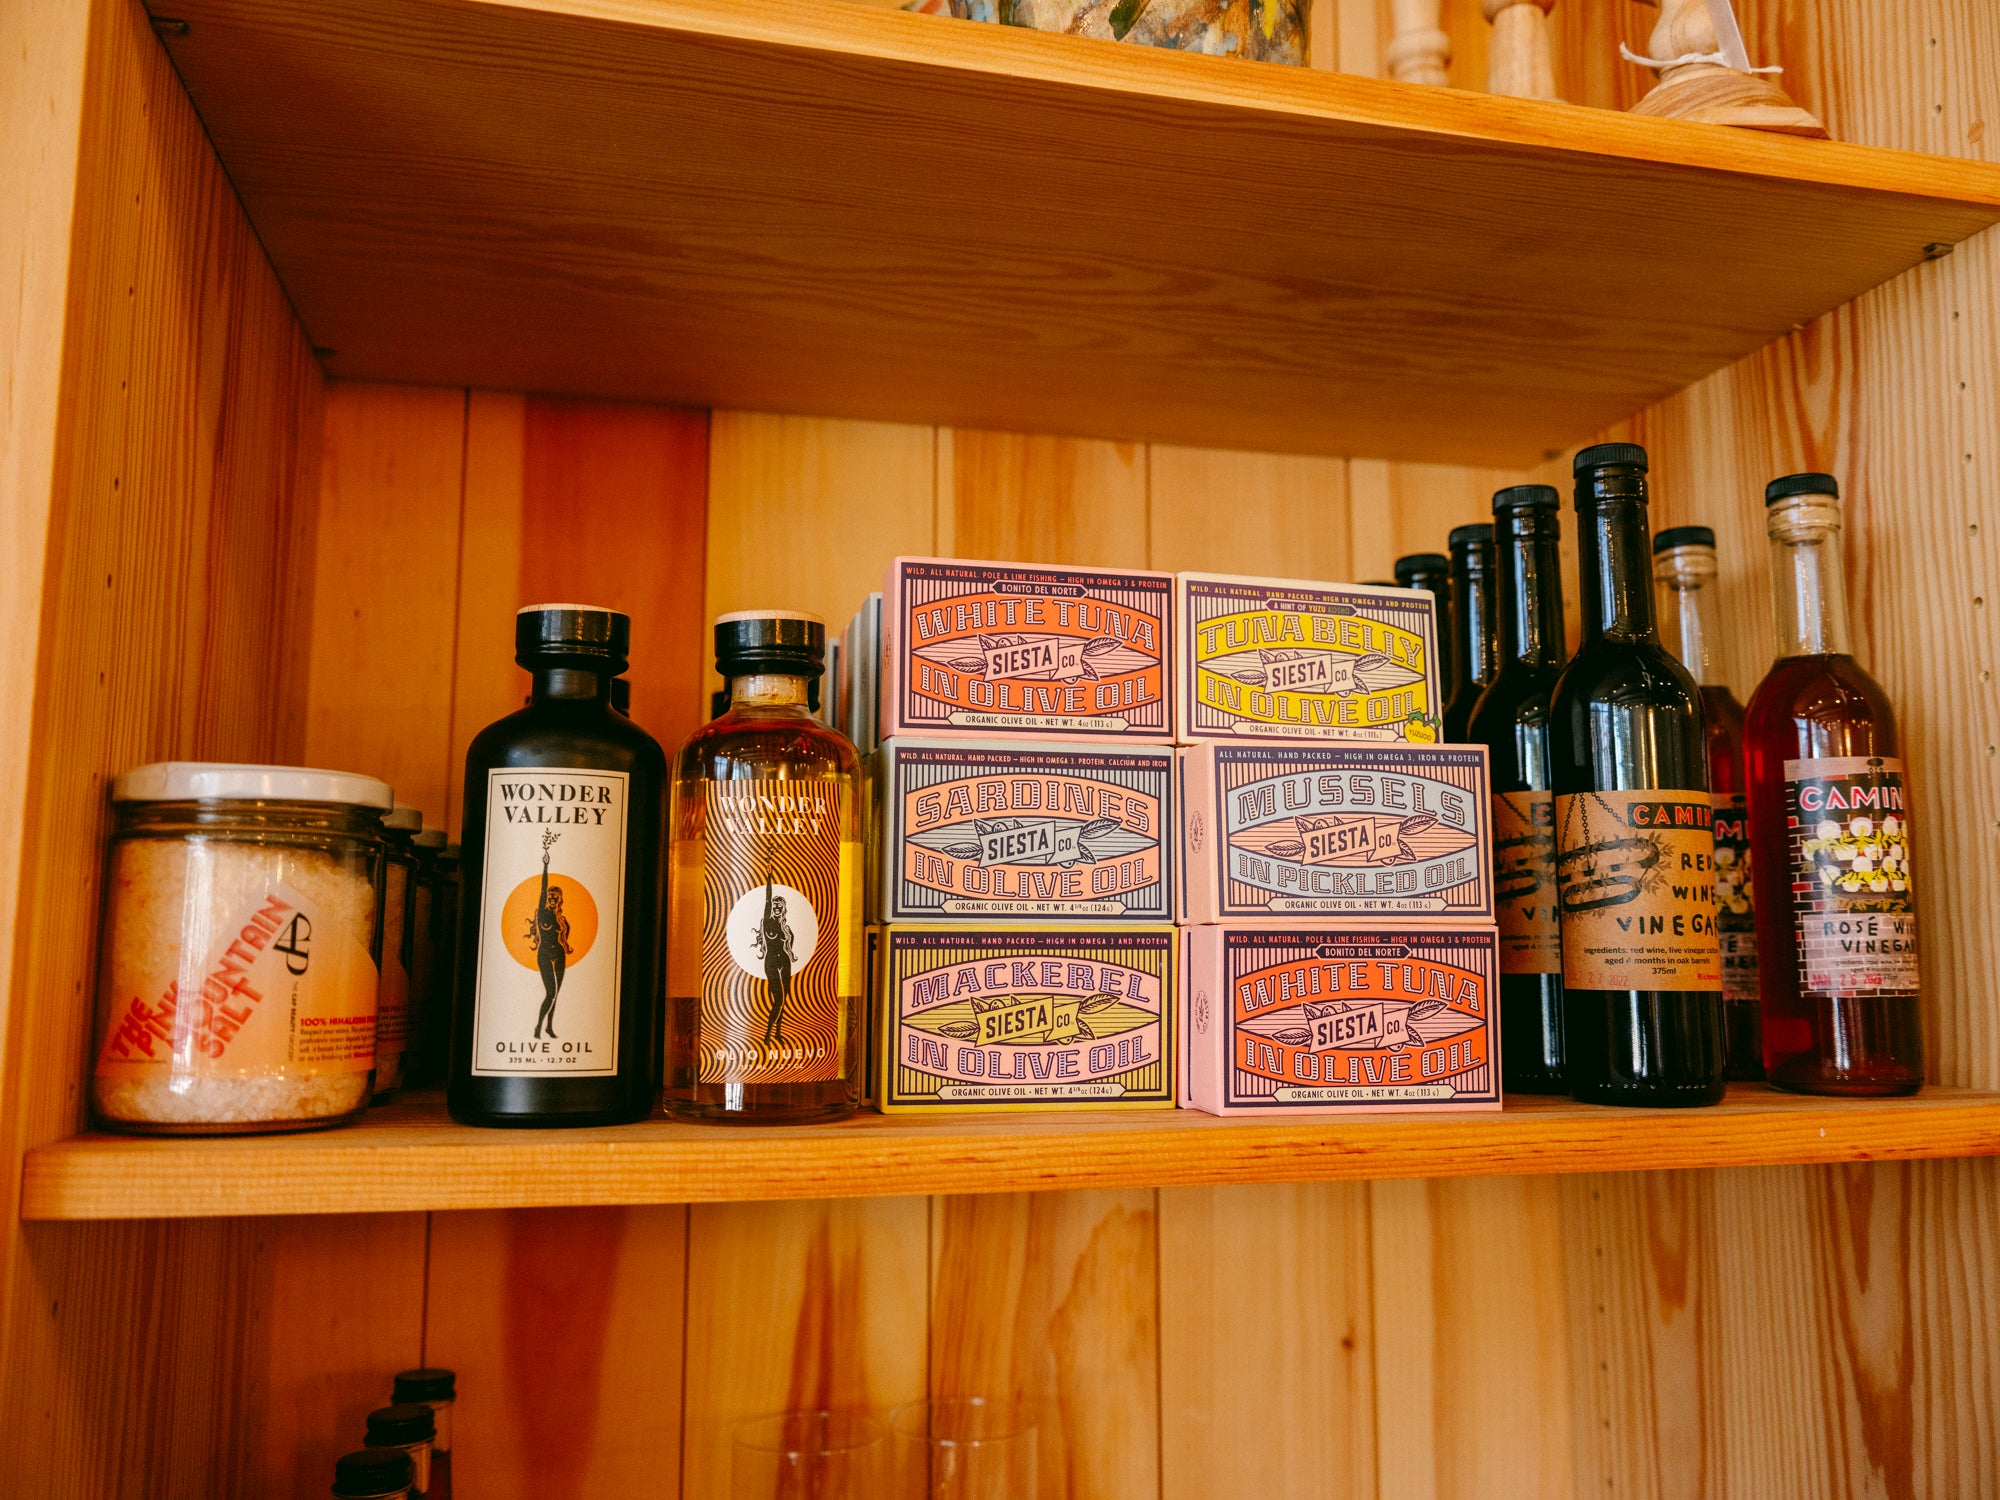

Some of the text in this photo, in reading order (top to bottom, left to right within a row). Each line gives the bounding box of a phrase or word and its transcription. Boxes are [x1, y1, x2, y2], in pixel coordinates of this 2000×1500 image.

[983, 571, 1000, 580] POLE
[1029, 574, 1057, 583] FISHING
[1067, 576, 1085, 584] HIGH
[1096, 578, 1121, 586] OMEGA
[1001, 583, 1078, 596] BONITO DEL NORTE
[1214, 586, 1227, 594] ALL
[1288, 592, 1314, 600] PACKED
[1322, 595, 1339, 603] HIGH
[1352, 598, 1376, 606] OMEGA
[1385, 600, 1399, 608] AND
[1401, 602, 1430, 610] PROTEIN
[1280, 602, 1350, 615] HINT YUZU KOSHO
[916, 598, 1155, 650] WHITE TUNA
[1199, 615, 1421, 668] TUNA BELLY
[993, 645, 1053, 675] SIESTA
[1272, 660, 1327, 688] SIESTA
[920, 664, 1155, 712] IN OLIVE OIL
[1206, 676, 1421, 724] IN OLIVE OIL
[965, 715, 1059, 726] ORGANIC OLIVE OIL NET
[1249, 725, 1336, 737] ORGANIC OLIVE OIL NET
[968, 754, 985, 762] HAND
[987, 755, 1011, 763] PACKED
[1108, 759, 1135, 767] CALCIUM
[1138, 759, 1150, 767] AND
[1152, 760, 1167, 768] IRON
[1302, 752, 1332, 760] PACKED
[1344, 752, 1363, 760] HIGH
[1377, 753, 1404, 761] OMEGA
[1418, 754, 1437, 762] IRON
[1448, 755, 1480, 763] PROTEIN
[500, 783, 613, 804] WONDER
[1237, 775, 1465, 826] MUSSELS
[504, 805, 607, 825] VALLEY
[720, 795, 828, 815] WONDER
[916, 780, 1149, 832] SARDINES
[725, 817, 823, 836] VALLEY
[988, 828, 1049, 861] SIESTA
[1310, 825, 1370, 859] SIESTA
[1681, 853, 1712, 872] RED
[914, 851, 1153, 898] IN OLIVE OIL
[1239, 853, 1472, 895] IN PICKLED OIL
[1284, 900, 1378, 909] ORGANIC OLIVE OIL NET
[1672, 885, 1716, 905] WINE
[955, 902, 1050, 911] ORGANIC OLIVE OIL NET
[1824, 916, 1878, 936] ROSÉ
[922, 937, 1168, 945] ALL HAND PACKED HIGH OMEGA AND PROTEIN
[1253, 935, 1266, 943] ALL
[1305, 936, 1324, 944] POLE
[1334, 936, 1350, 944] LINE
[1352, 936, 1380, 944] FISHING
[1391, 936, 1408, 944] HIGH
[1420, 936, 1445, 944] OMEGA
[1462, 936, 1491, 944] PROTEIN
[1325, 947, 1401, 957] BONITO DEL NORTE
[1646, 947, 1667, 955] wine,
[1604, 957, 1624, 966] aged
[1651, 967, 1677, 975] 375ml
[911, 961, 1150, 1008] MACKEREL
[1240, 962, 1370, 1013] WHITE
[1376, 962, 1480, 1011] TUNA
[110, 997, 153, 1058] THE
[135, 978, 185, 1058] PINK
[193, 977, 263, 1059] SALT
[301, 1018, 326, 1027] 100%
[986, 1004, 1048, 1039] SIESTA
[1317, 1010, 1378, 1046] SIESTA
[496, 1041, 593, 1053] OLIVE OIL
[716, 1047, 826, 1061] OLIO NUEVO
[908, 1034, 1152, 1079] IN OLIVE OIL
[1245, 1038, 1481, 1083] IN OLIVE OIL
[951, 1087, 1048, 1097] ORGANIC OLIVE OIL NET
[1291, 1089, 1385, 1099] ORGANIC OLIVE OIL NET
